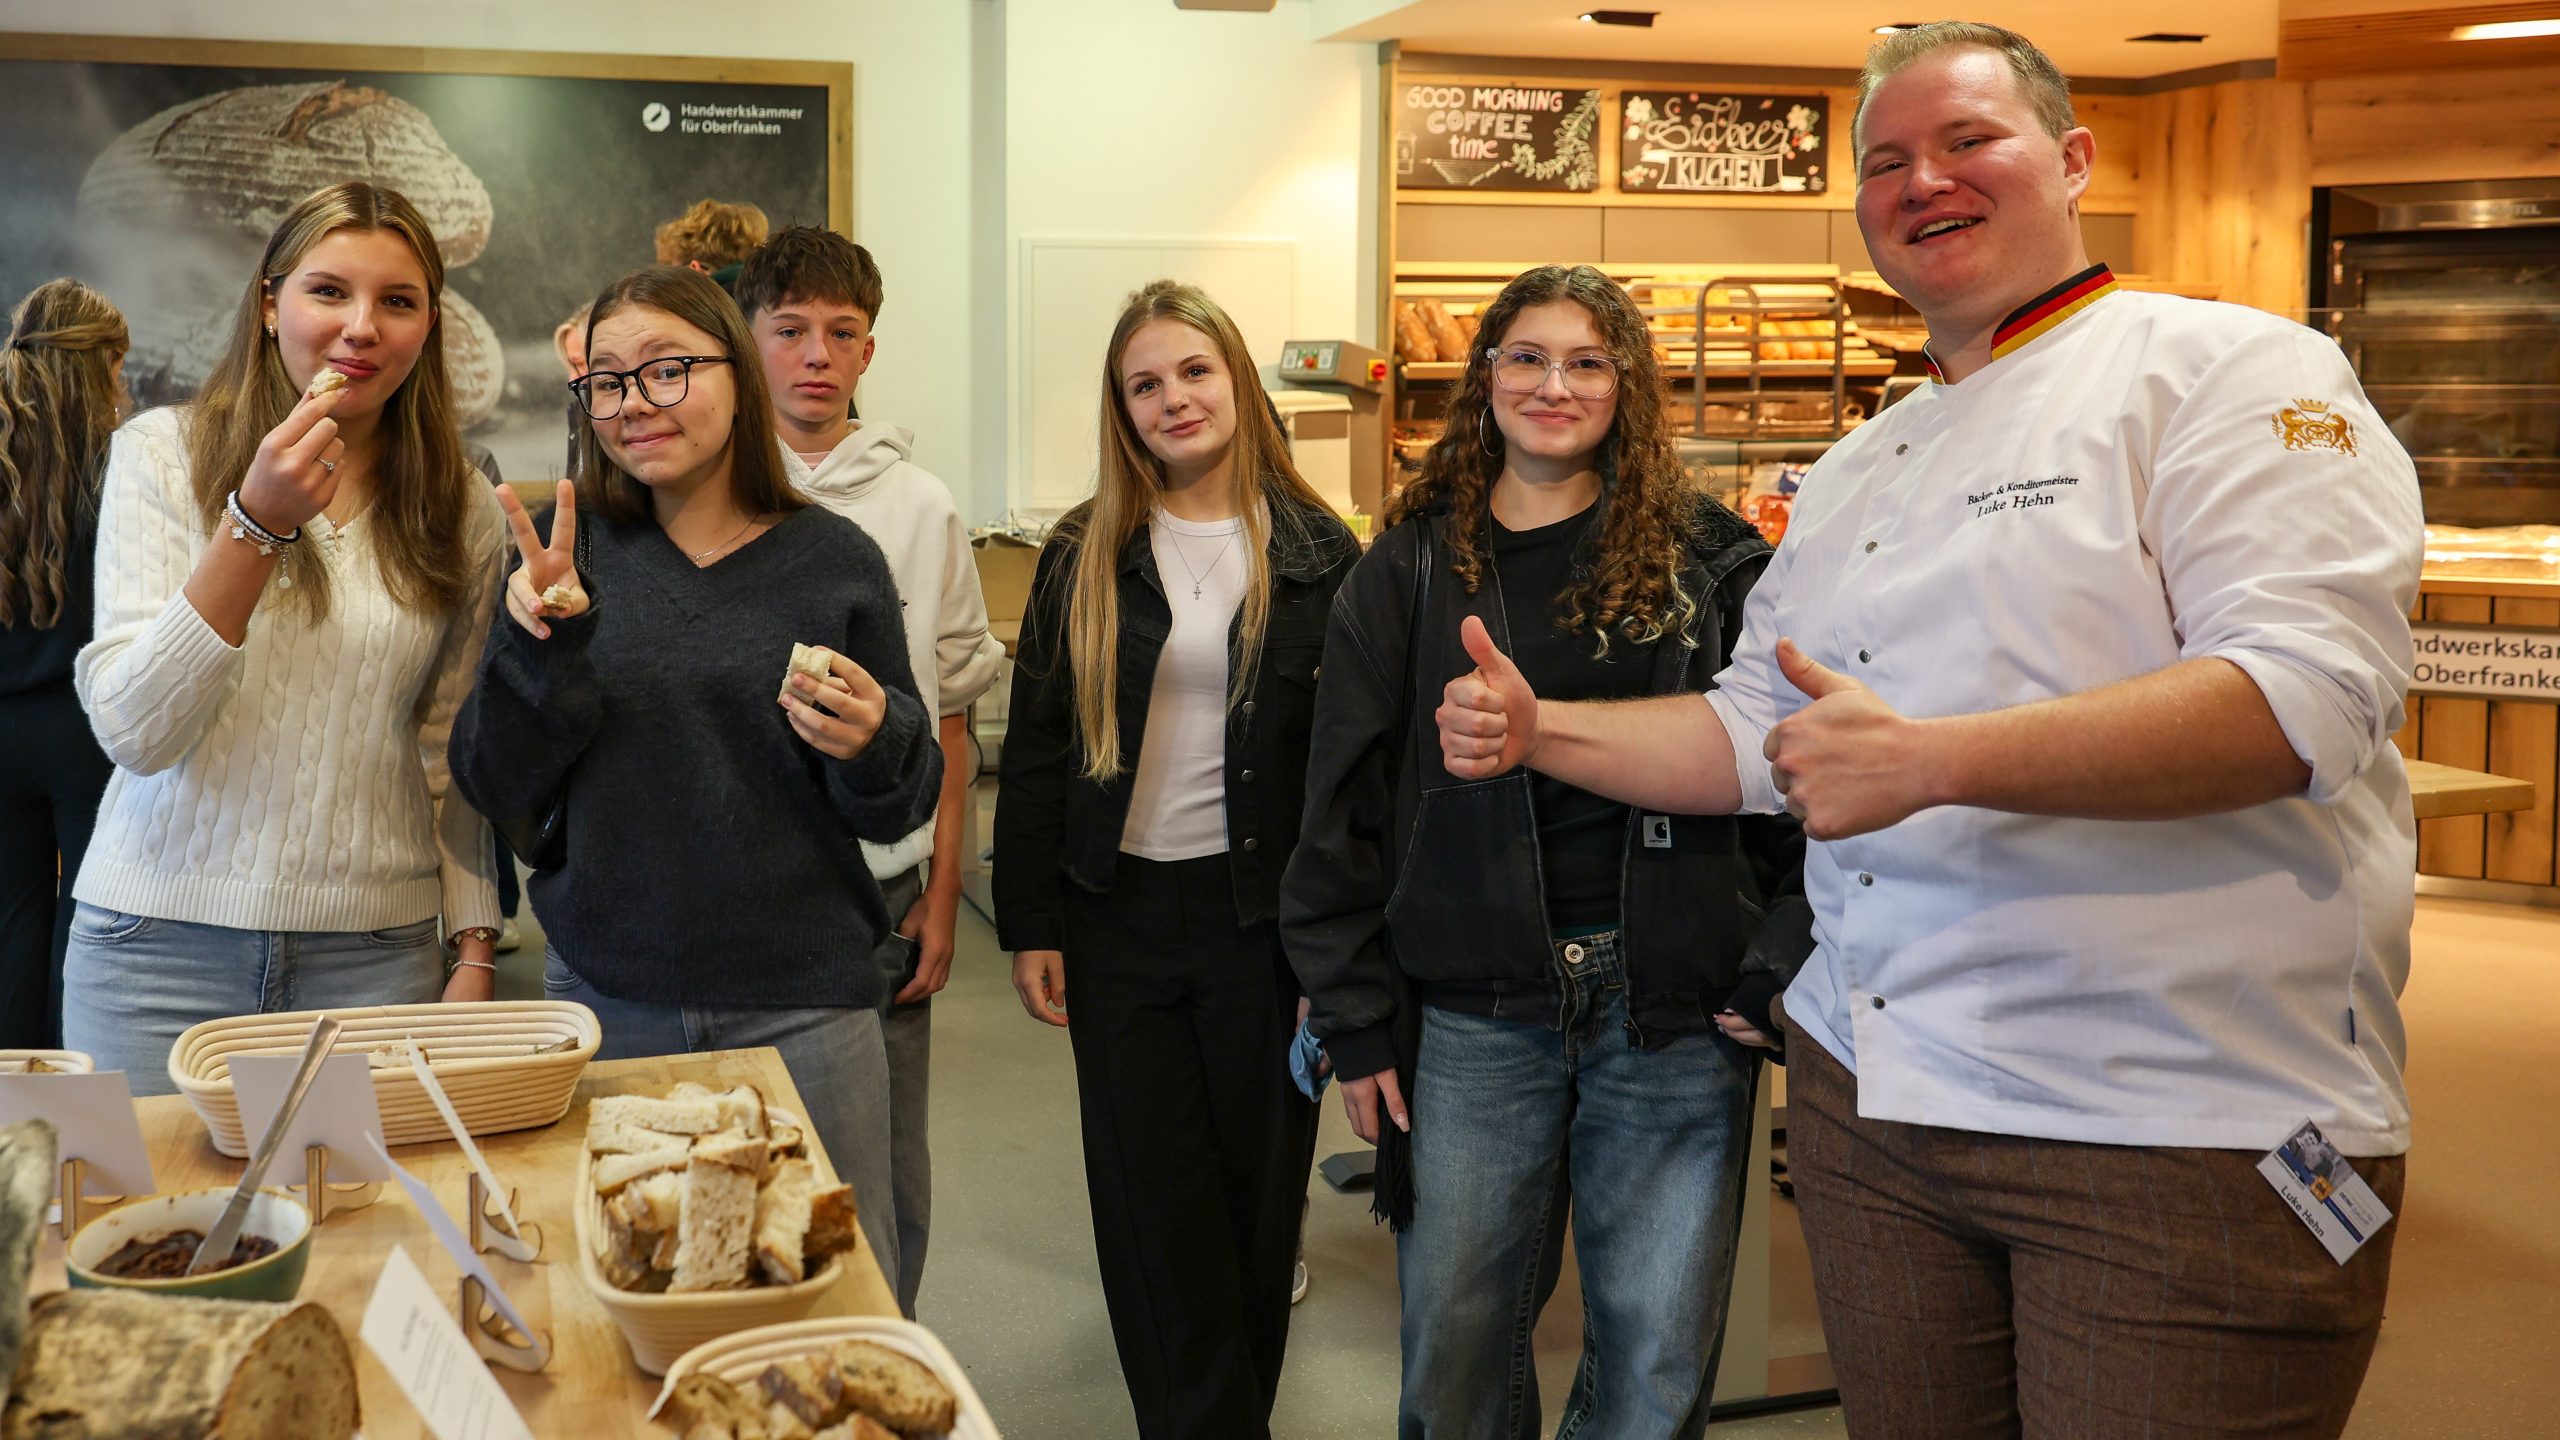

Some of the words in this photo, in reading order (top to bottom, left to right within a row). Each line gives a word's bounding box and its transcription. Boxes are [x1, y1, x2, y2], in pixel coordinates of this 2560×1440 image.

[680, 103, 804, 120] Handwerkskammer
[1406, 86, 1466, 109] GOOD
[1472, 87, 1563, 113] MORNING
[680, 119, 701, 133] für
[702, 119, 782, 136] Oberfranken
[1426, 109, 1534, 141] COFFEE
[1448, 134, 1500, 160] time
[1674, 155, 1766, 188] KUCHEN
[1996, 485, 2005, 496] &
[2006, 475, 2080, 493] Konditormeister
[1976, 499, 2007, 518] Luke
[2011, 493, 2055, 509] Hehn
[2413, 634, 2560, 661] ndwerkska
[2280, 1185, 2303, 1211] Luke
[2302, 1209, 2325, 1238] Hehn
